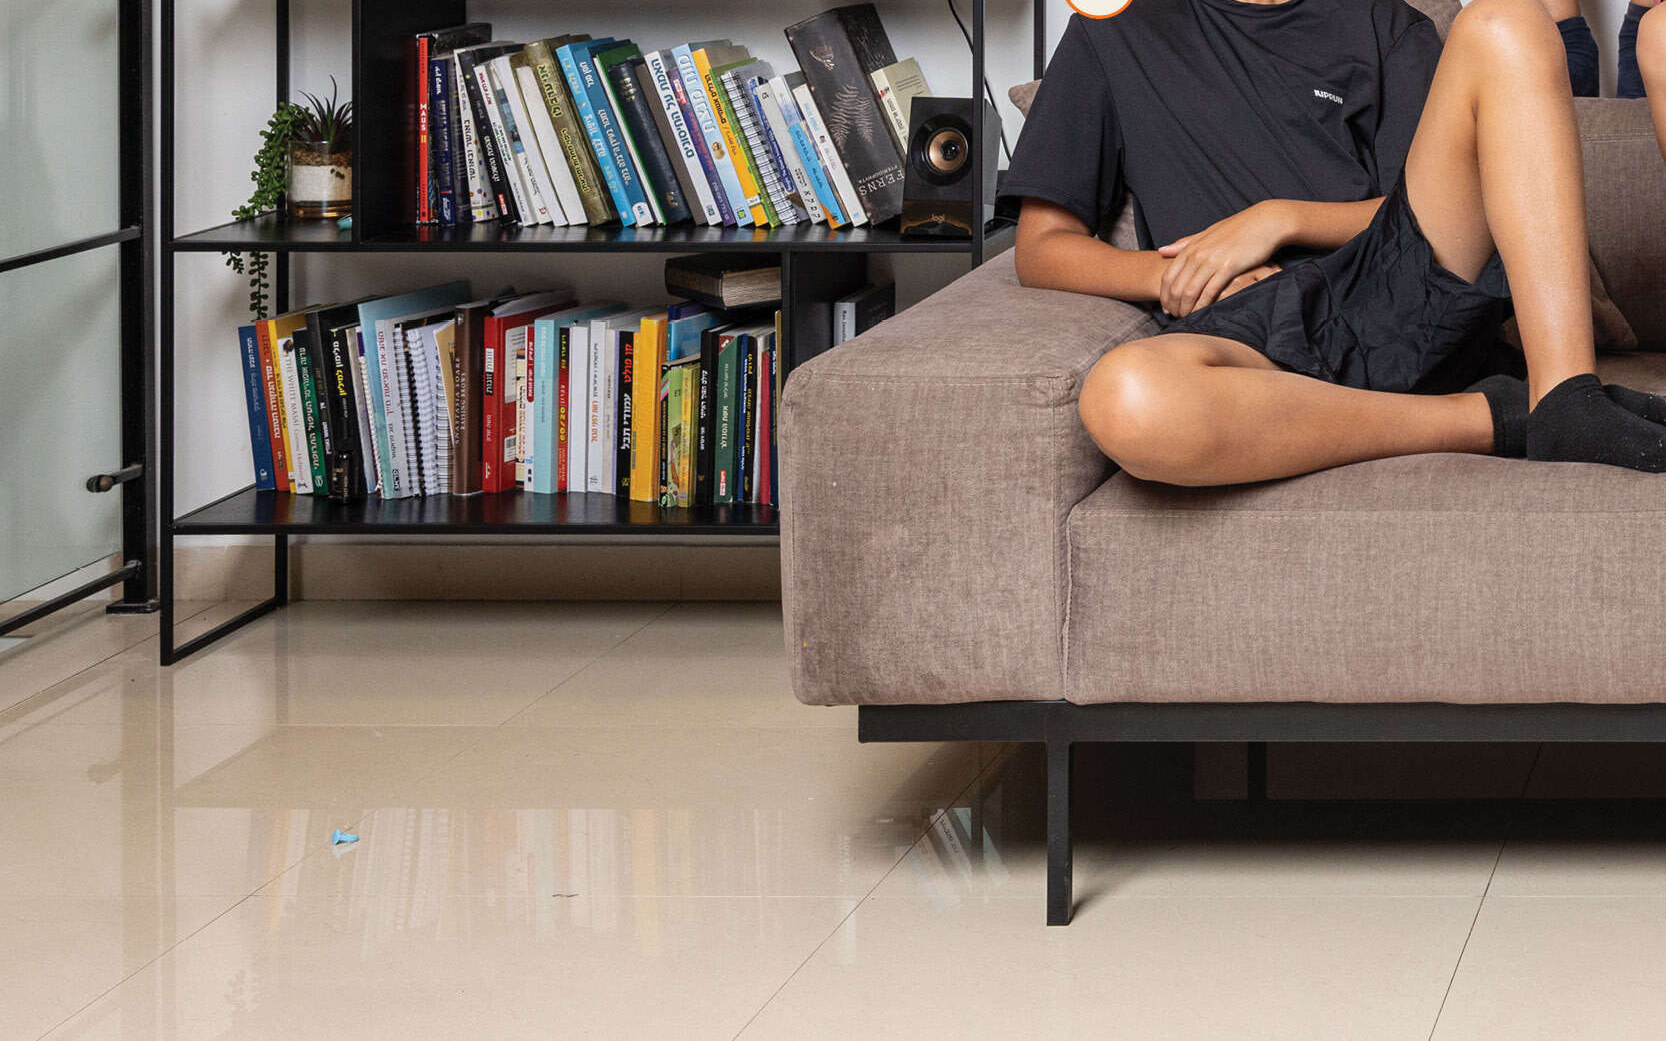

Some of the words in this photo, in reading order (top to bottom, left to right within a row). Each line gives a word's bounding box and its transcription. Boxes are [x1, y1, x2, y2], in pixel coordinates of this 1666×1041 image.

[537, 64, 550, 82] אני
[677, 54, 696, 85] מוח
[689, 89, 716, 133] מנצח
[419, 103, 428, 131] MAUS
[650, 58, 669, 91] האמת
[662, 94, 675, 110] על
[671, 111, 695, 159] החיסונים
[464, 119, 473, 149] באושר
[466, 151, 475, 181] ובאושר
[857, 169, 905, 197] FERNS
[931, 213, 946, 224] logi
[332, 341, 344, 367] מלימון
[623, 342, 632, 355] קן
[335, 369, 348, 396] למיליון
[621, 358, 632, 383] פולט
[287, 374, 296, 401] WHITE
[290, 403, 299, 428] MASAI
[623, 392, 632, 424] עמודי
[721, 405, 729, 421] אשת
[620, 427, 631, 449] תבל
[720, 422, 729, 448] הסנדלר
